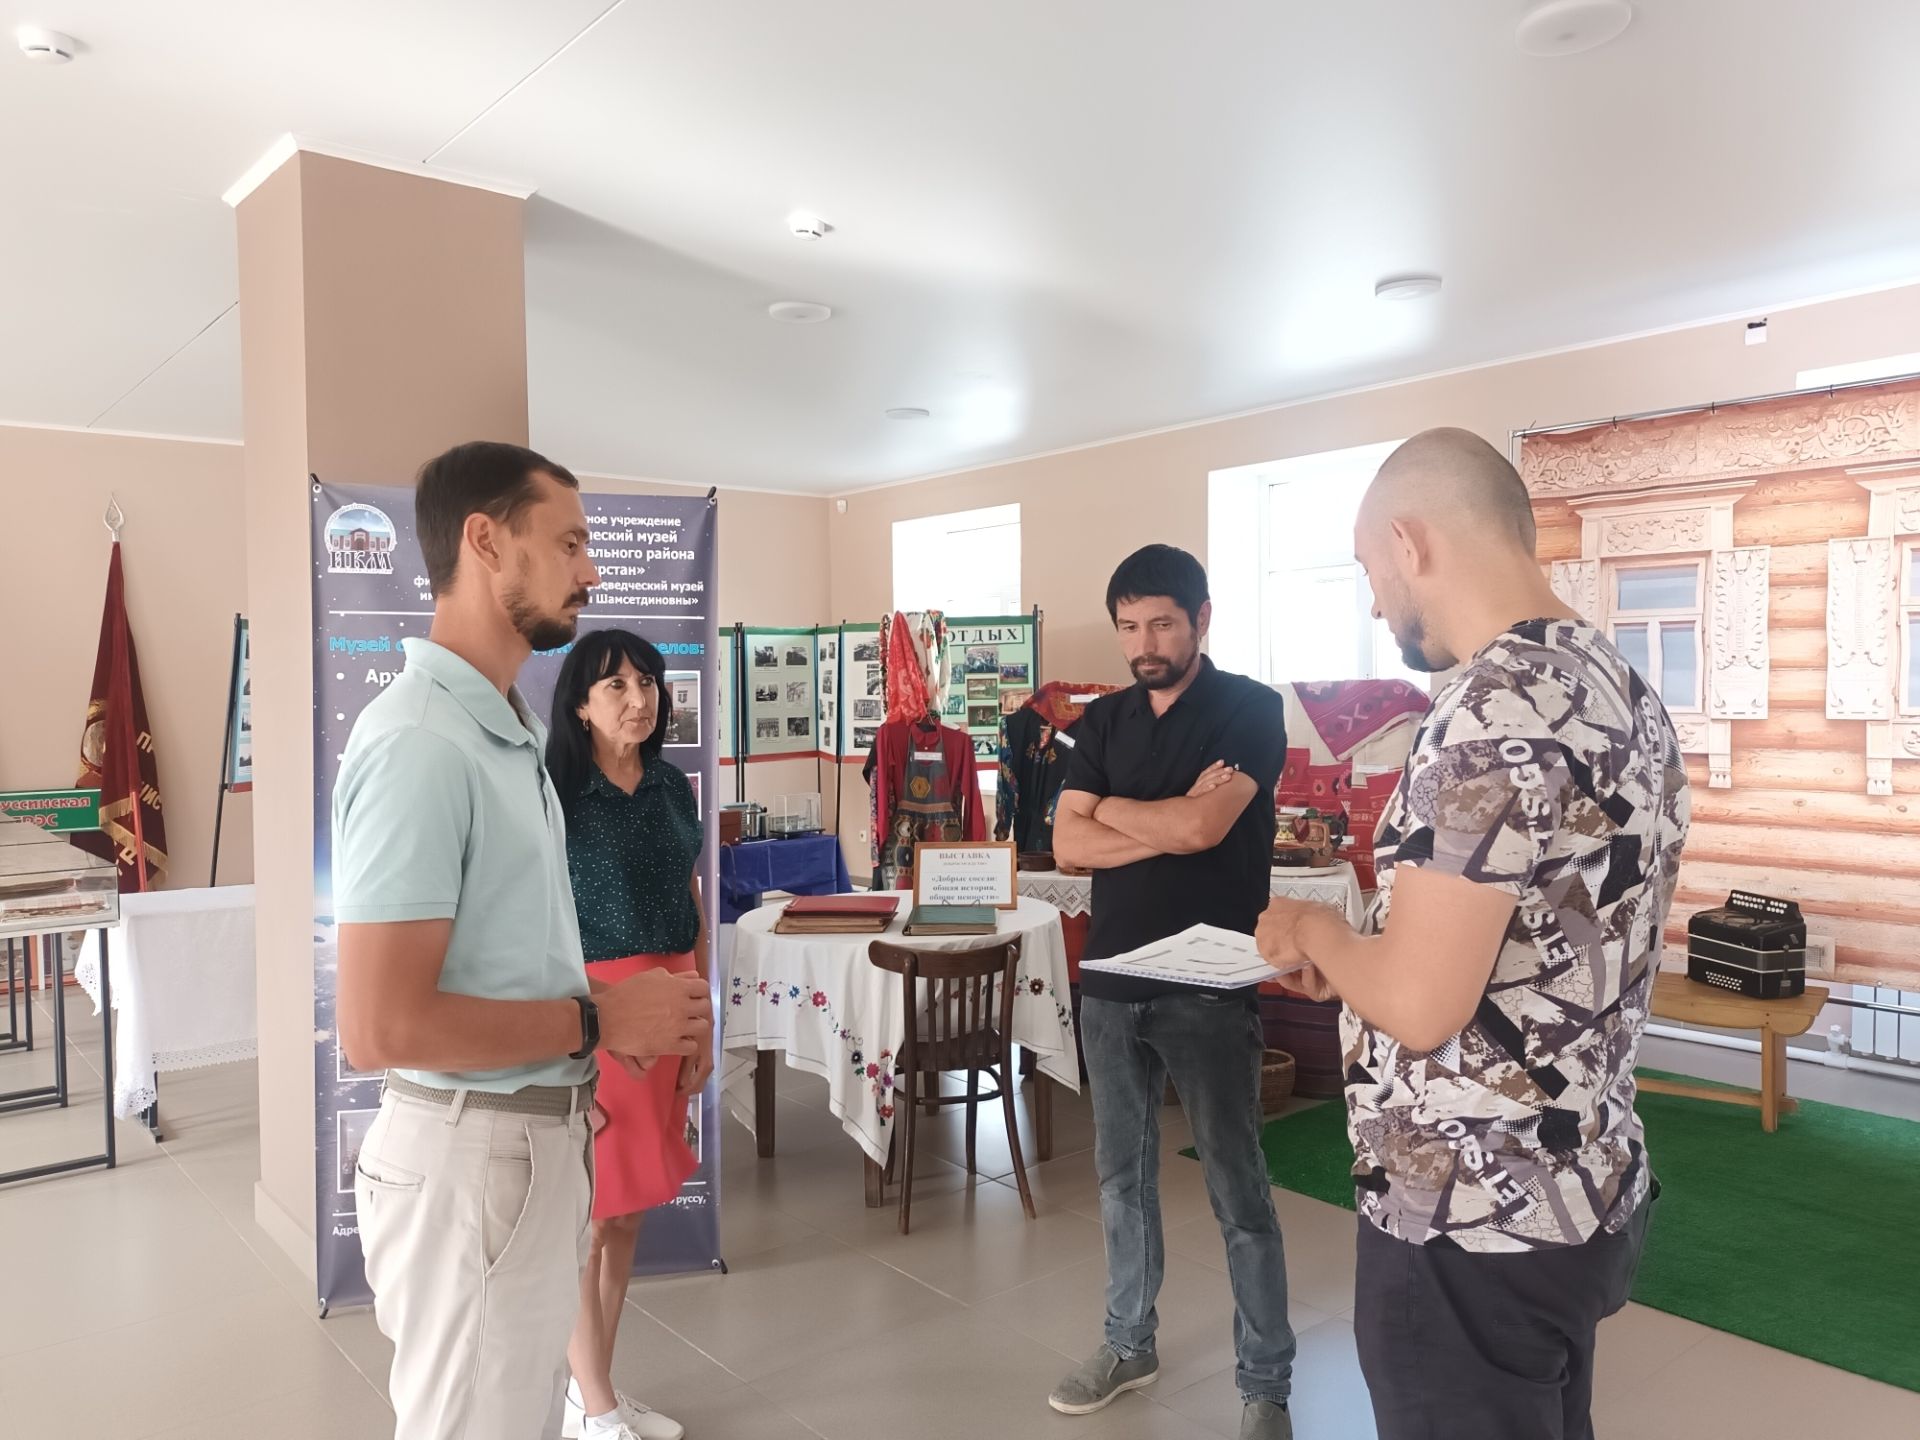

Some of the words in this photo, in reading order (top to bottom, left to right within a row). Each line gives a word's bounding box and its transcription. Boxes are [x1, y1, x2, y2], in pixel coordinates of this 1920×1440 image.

[610, 516, 682, 527] учреждение
[637, 530, 678, 544] музей
[646, 547, 695, 561] района
[594, 566, 646, 576] рстан»
[670, 581, 704, 593] музей
[329, 636, 391, 656] Музей
[652, 643, 705, 655] елов:
